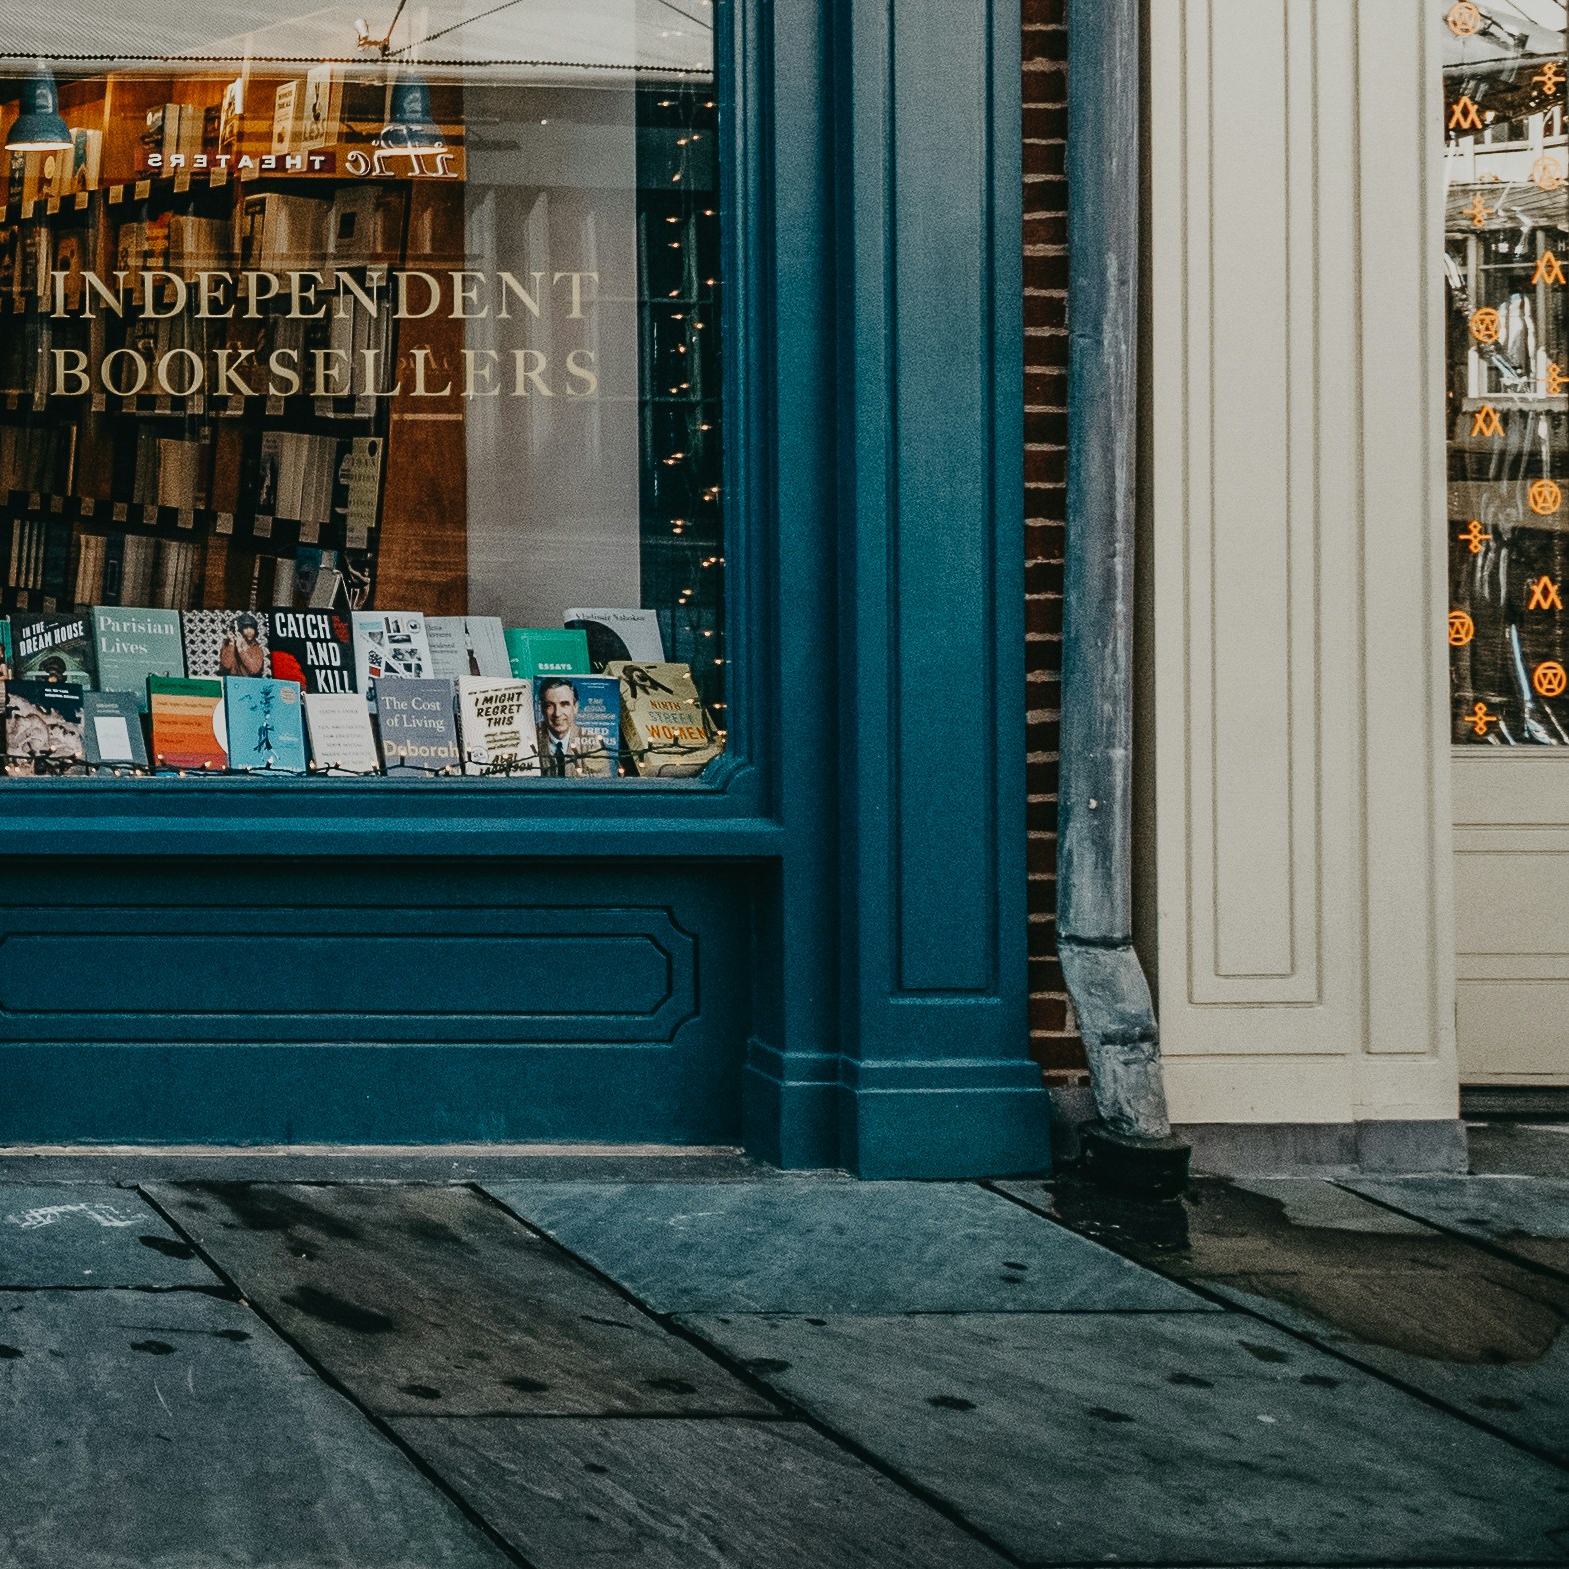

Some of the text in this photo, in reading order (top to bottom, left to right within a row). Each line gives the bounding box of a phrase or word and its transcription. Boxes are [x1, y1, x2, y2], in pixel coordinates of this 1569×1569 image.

[50, 270, 599, 320] INDEPENDENT
[50, 347, 600, 397] BOOKSELLERS
[21, 621, 45, 639] IN THE
[98, 615, 175, 635] Parisian
[274, 612, 332, 640] CATCH
[18, 620, 85, 657] DREAM HOUSE
[100, 637, 149, 654] Lives
[306, 641, 342, 667] AND
[537, 662, 573, 672] ESSAYS
[314, 668, 354, 694] KILL
[381, 696, 442, 712] The Cost
[474, 691, 524, 707] I MIGHT
[649, 699, 682, 711] NINTH
[476, 703, 524, 718] REGRET
[385, 713, 446, 732] of Living
[486, 715, 515, 728] THIS
[581, 727, 610, 736] FRED
[646, 724, 706, 741] WOMEN
[383, 738, 459, 759] Deborah
